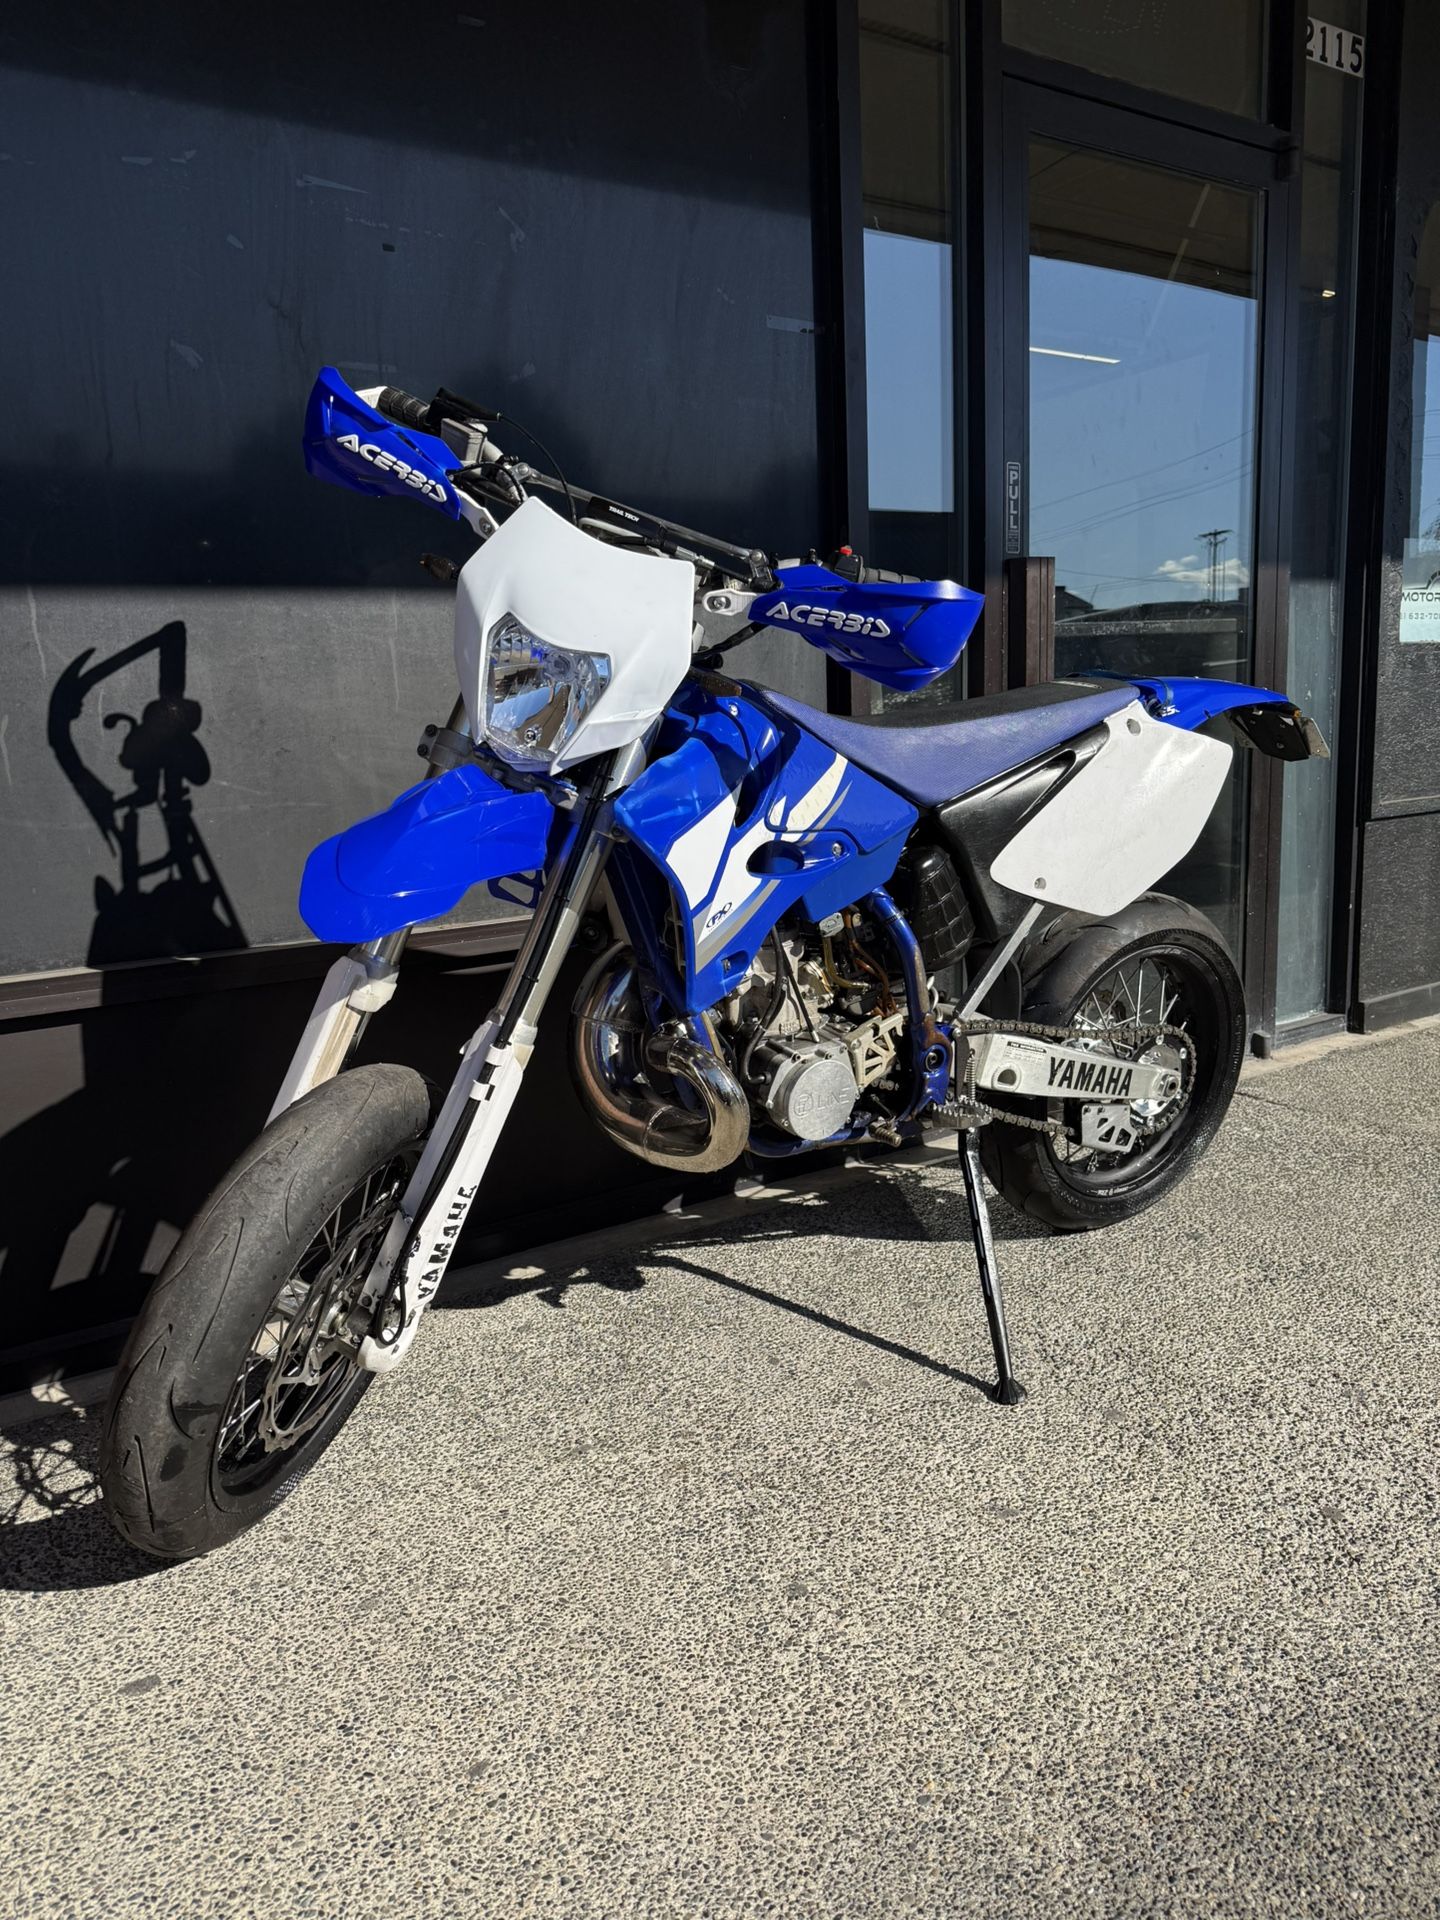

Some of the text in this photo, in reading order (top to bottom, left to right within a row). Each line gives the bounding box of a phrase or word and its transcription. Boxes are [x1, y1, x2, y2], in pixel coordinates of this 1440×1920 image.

[1306, 19, 1362, 73] 2115
[1009, 470, 1018, 529] PULL
[1048, 1056, 1133, 1097] YAMAHA
